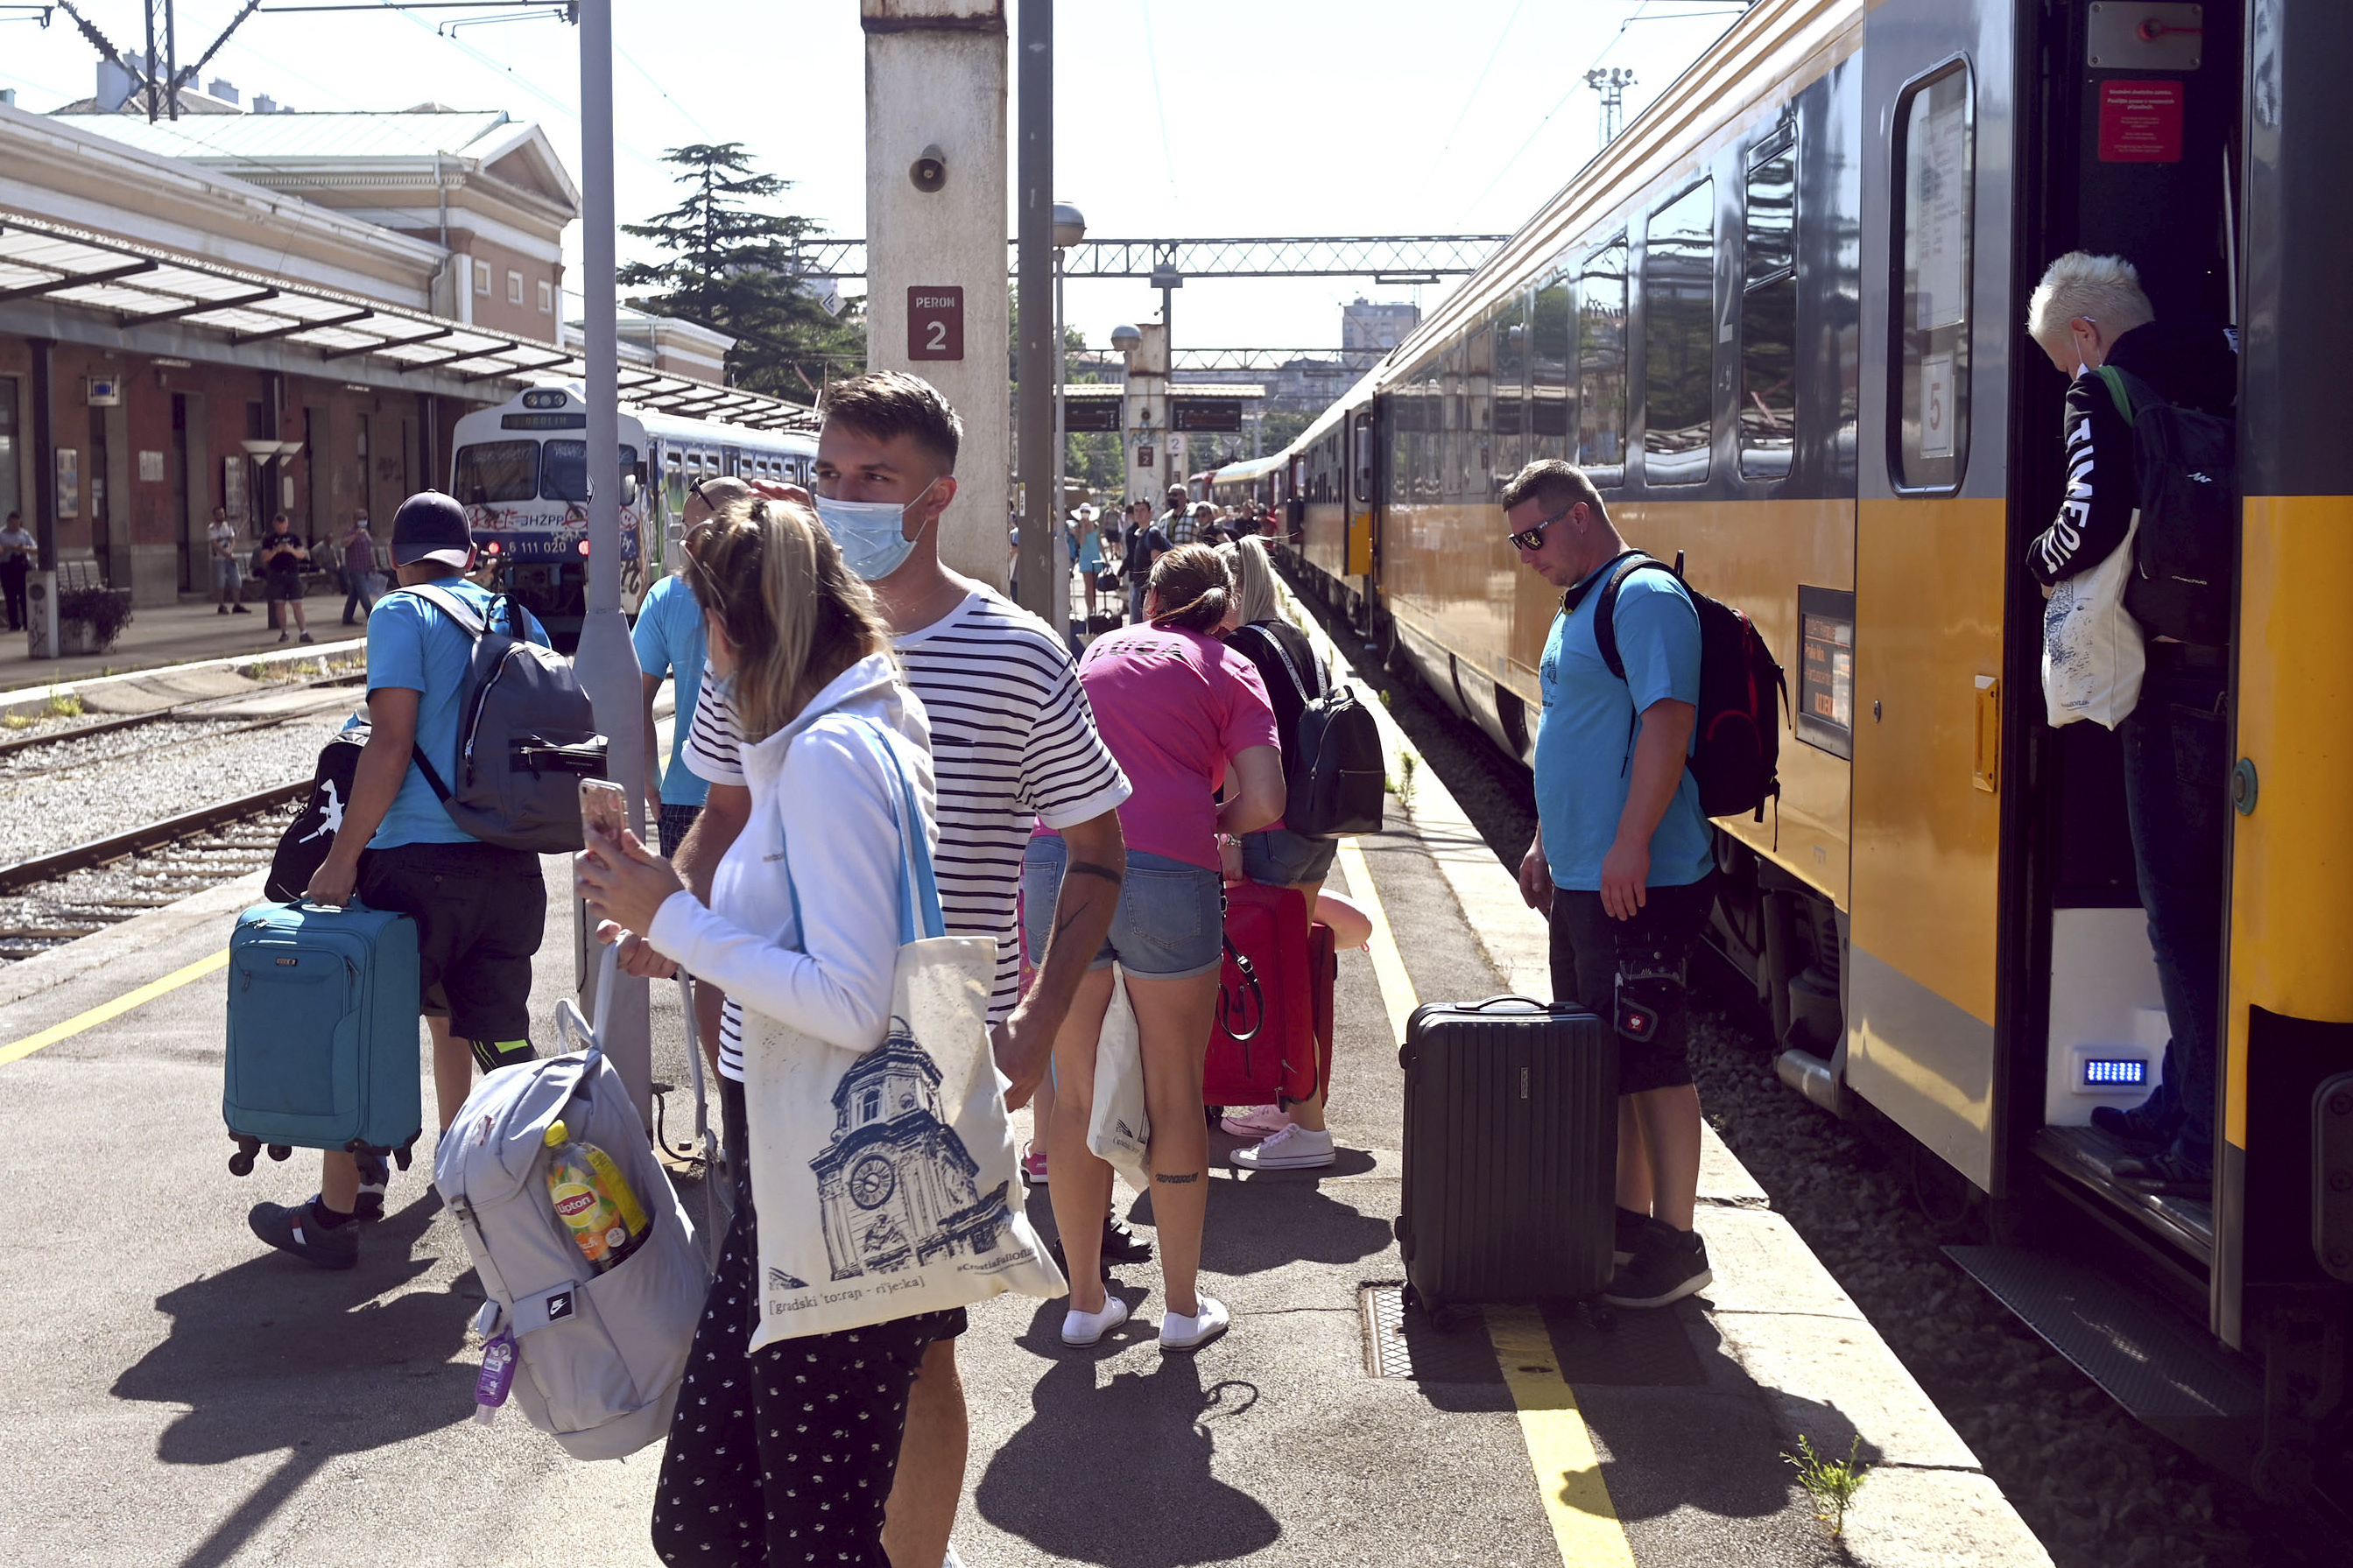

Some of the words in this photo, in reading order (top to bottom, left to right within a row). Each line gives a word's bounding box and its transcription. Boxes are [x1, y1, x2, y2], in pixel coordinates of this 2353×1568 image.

[915, 297, 955, 308] PERON
[926, 320, 946, 350] 2
[1929, 382, 1941, 431] 5
[1171, 438, 1180, 450] 2
[509, 541, 517, 552] 6
[521, 542, 538, 553] 111
[543, 541, 567, 553] 020
[556, 1195, 592, 1213] Lipton
